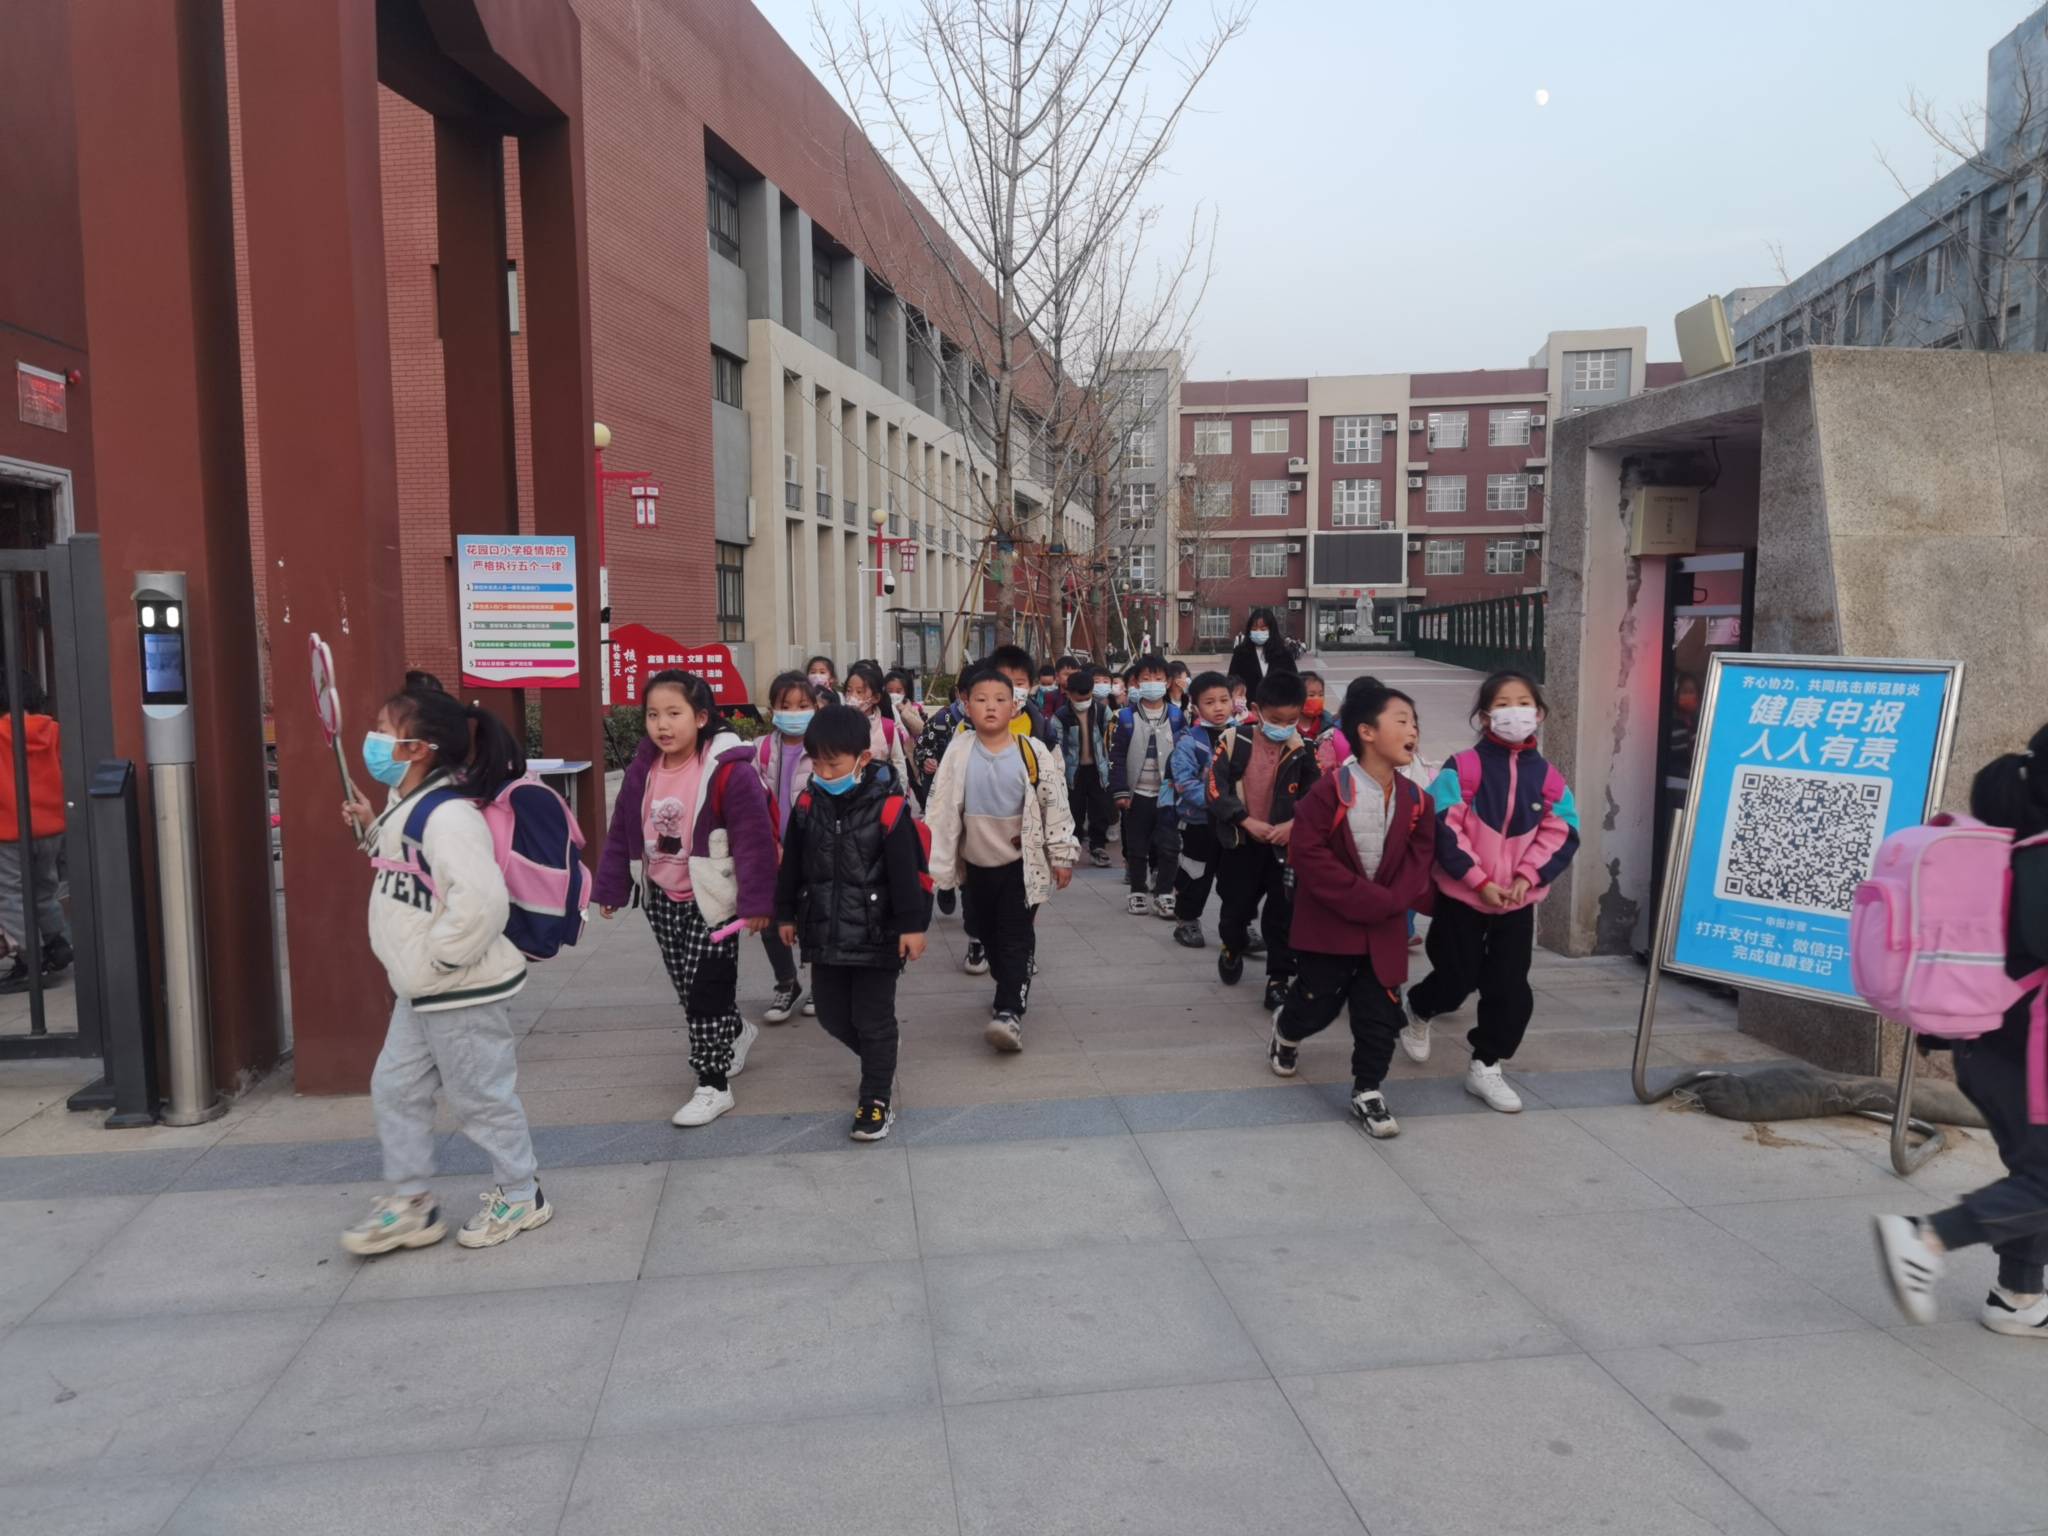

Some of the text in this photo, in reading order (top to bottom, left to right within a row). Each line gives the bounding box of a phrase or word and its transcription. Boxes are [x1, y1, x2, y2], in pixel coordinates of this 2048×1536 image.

[466, 544, 568, 556] 花园口小学疫情防控
[473, 560, 562, 571] 严格执行五个一律
[1749, 694, 1905, 734] 健康申报
[1739, 728, 1898, 771] 人人有责
[1732, 945, 1833, 976] 完成健康登记
